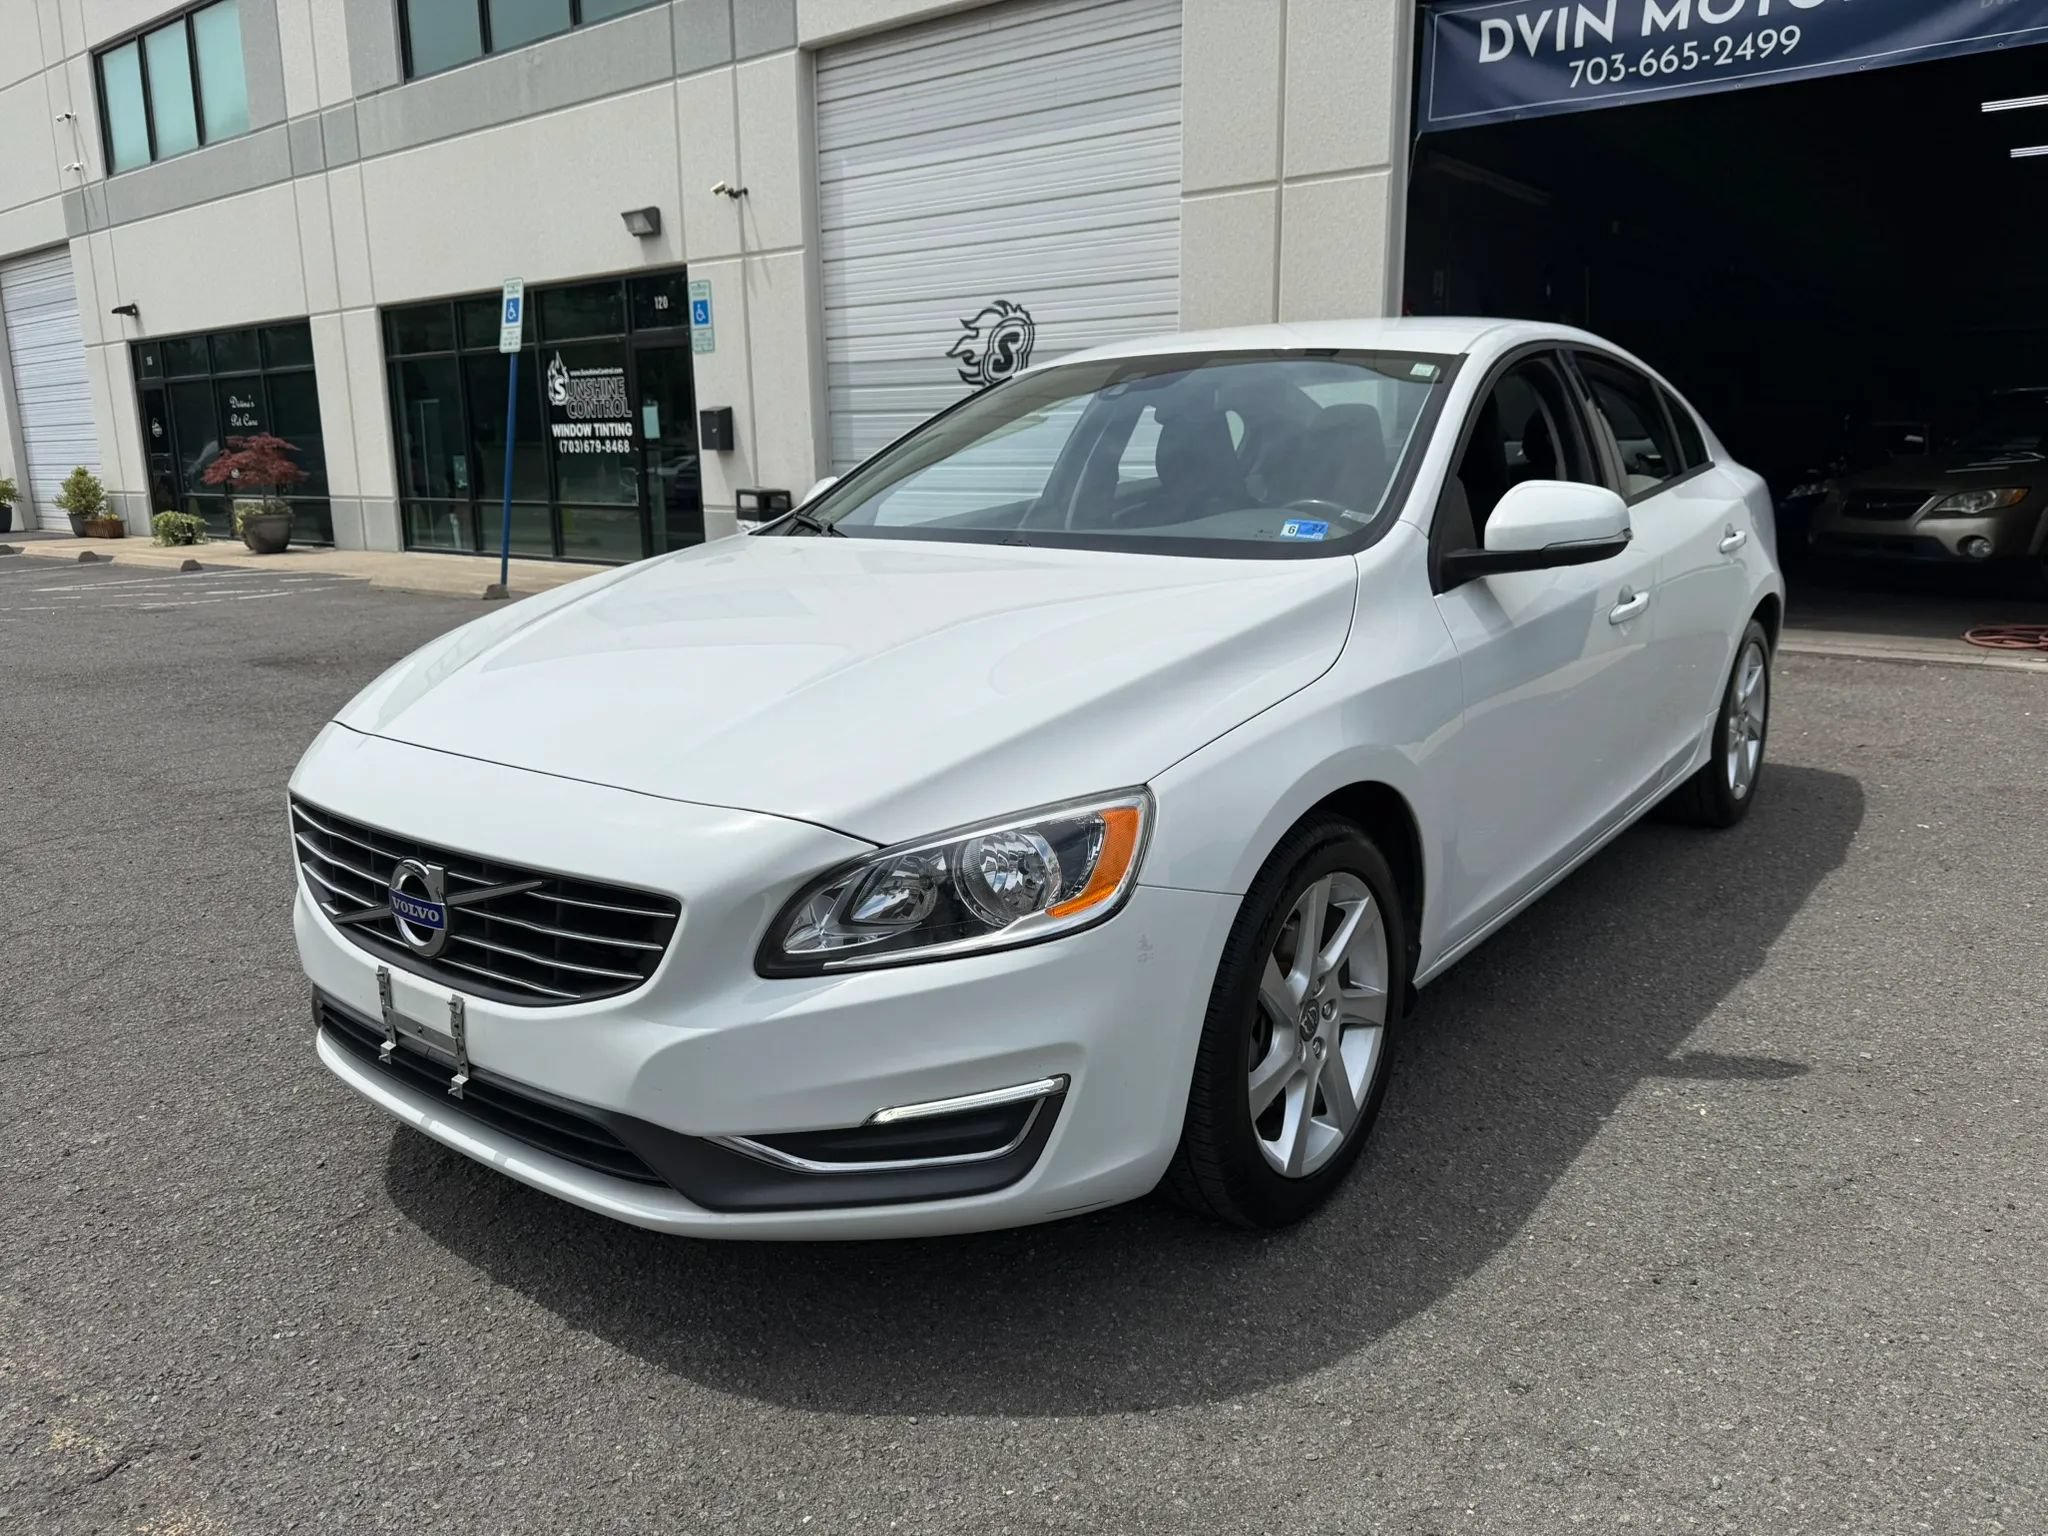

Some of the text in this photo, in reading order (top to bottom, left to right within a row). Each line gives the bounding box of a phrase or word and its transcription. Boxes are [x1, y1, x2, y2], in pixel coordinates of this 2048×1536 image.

[1479, 0, 1616, 63] DVIN
[1569, 25, 1801, 88] 703-665-2499
[653, 295, 669, 310] 120
[554, 377, 625, 400] SUNSHINE
[567, 397, 632, 418] CONTROL
[551, 422, 633, 437] WINDOW TINTING
[559, 439, 631, 454] (703)679-8468
[1288, 526, 1297, 534] 6
[391, 895, 441, 922] VOLVO
